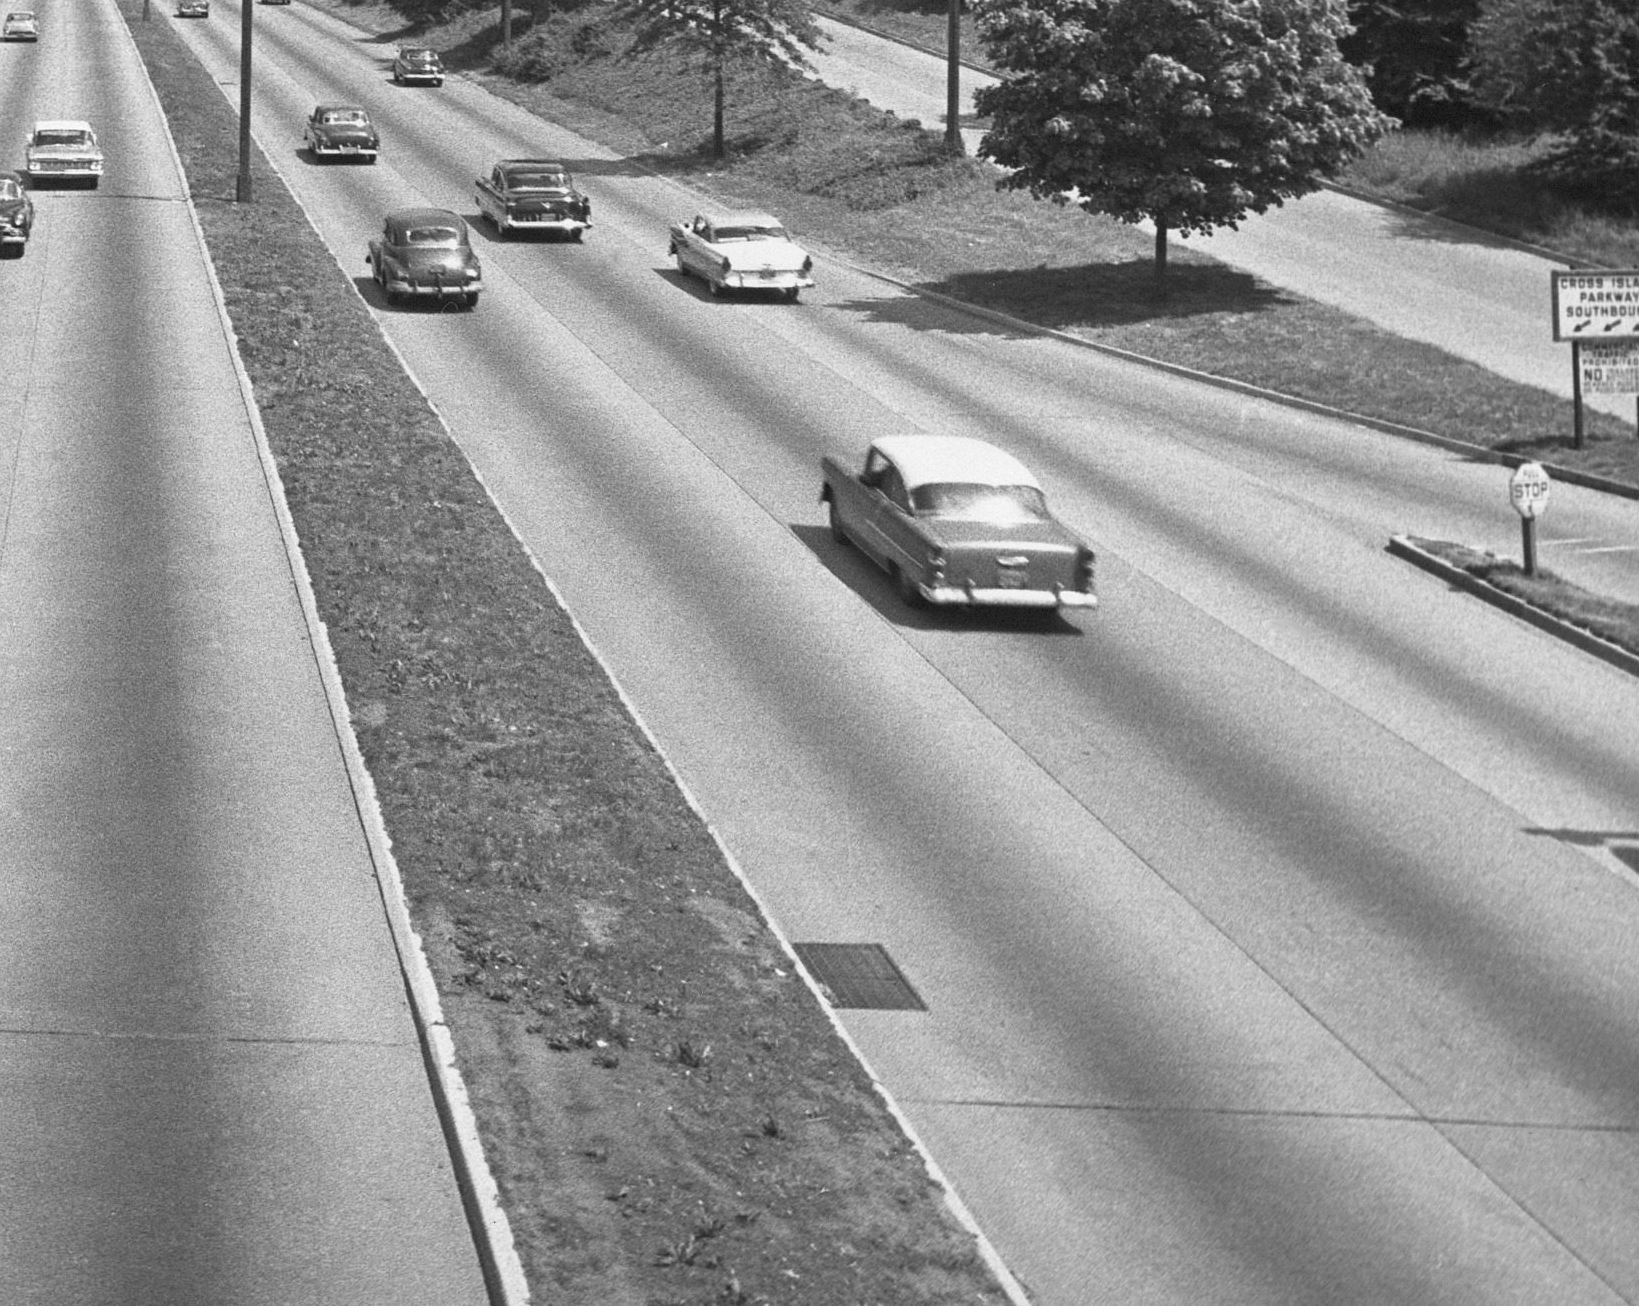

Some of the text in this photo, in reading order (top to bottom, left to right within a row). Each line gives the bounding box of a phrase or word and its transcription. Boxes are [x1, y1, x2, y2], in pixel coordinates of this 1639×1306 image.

[1561, 277, 1604, 289] CROSS
[1566, 305, 1639, 318] SOUTHBOU
[1584, 368, 1602, 381] NO
[1514, 481, 1548, 499] STOP
